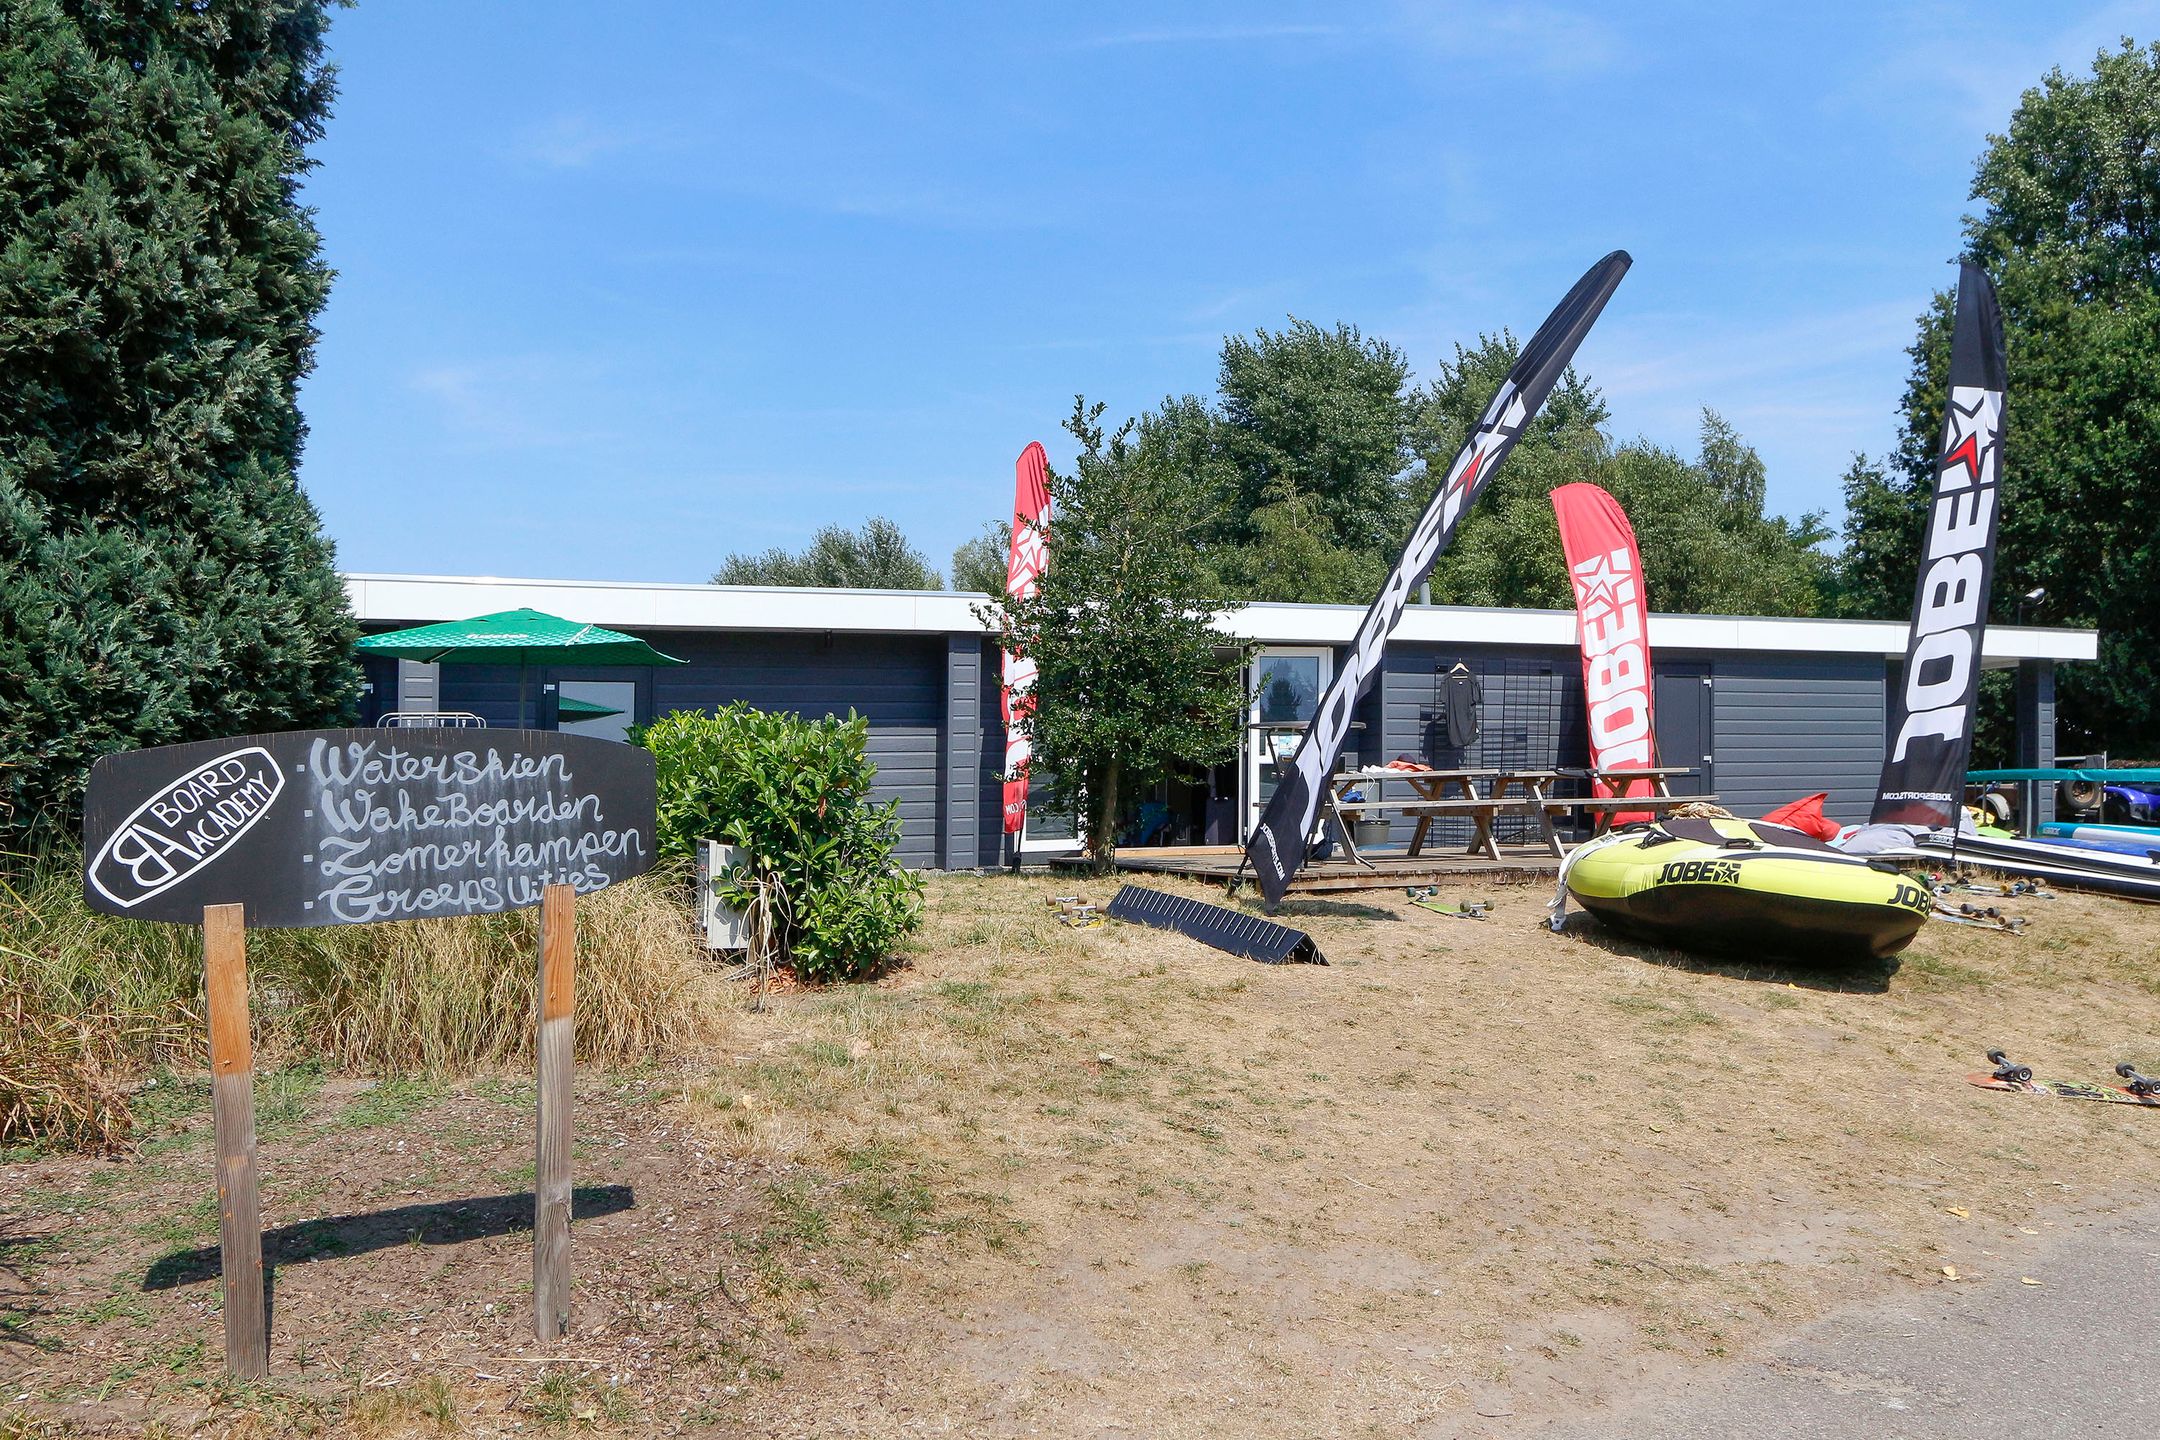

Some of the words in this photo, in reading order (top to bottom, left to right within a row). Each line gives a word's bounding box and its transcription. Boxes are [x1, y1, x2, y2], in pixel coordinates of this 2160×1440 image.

[1296, 487, 1445, 843] JOBE
[150, 758, 247, 828] BOARD
[186, 769, 273, 855] ACADEMY
[1656, 861, 1718, 885] JOBE
[1886, 883, 1932, 917] JOB
